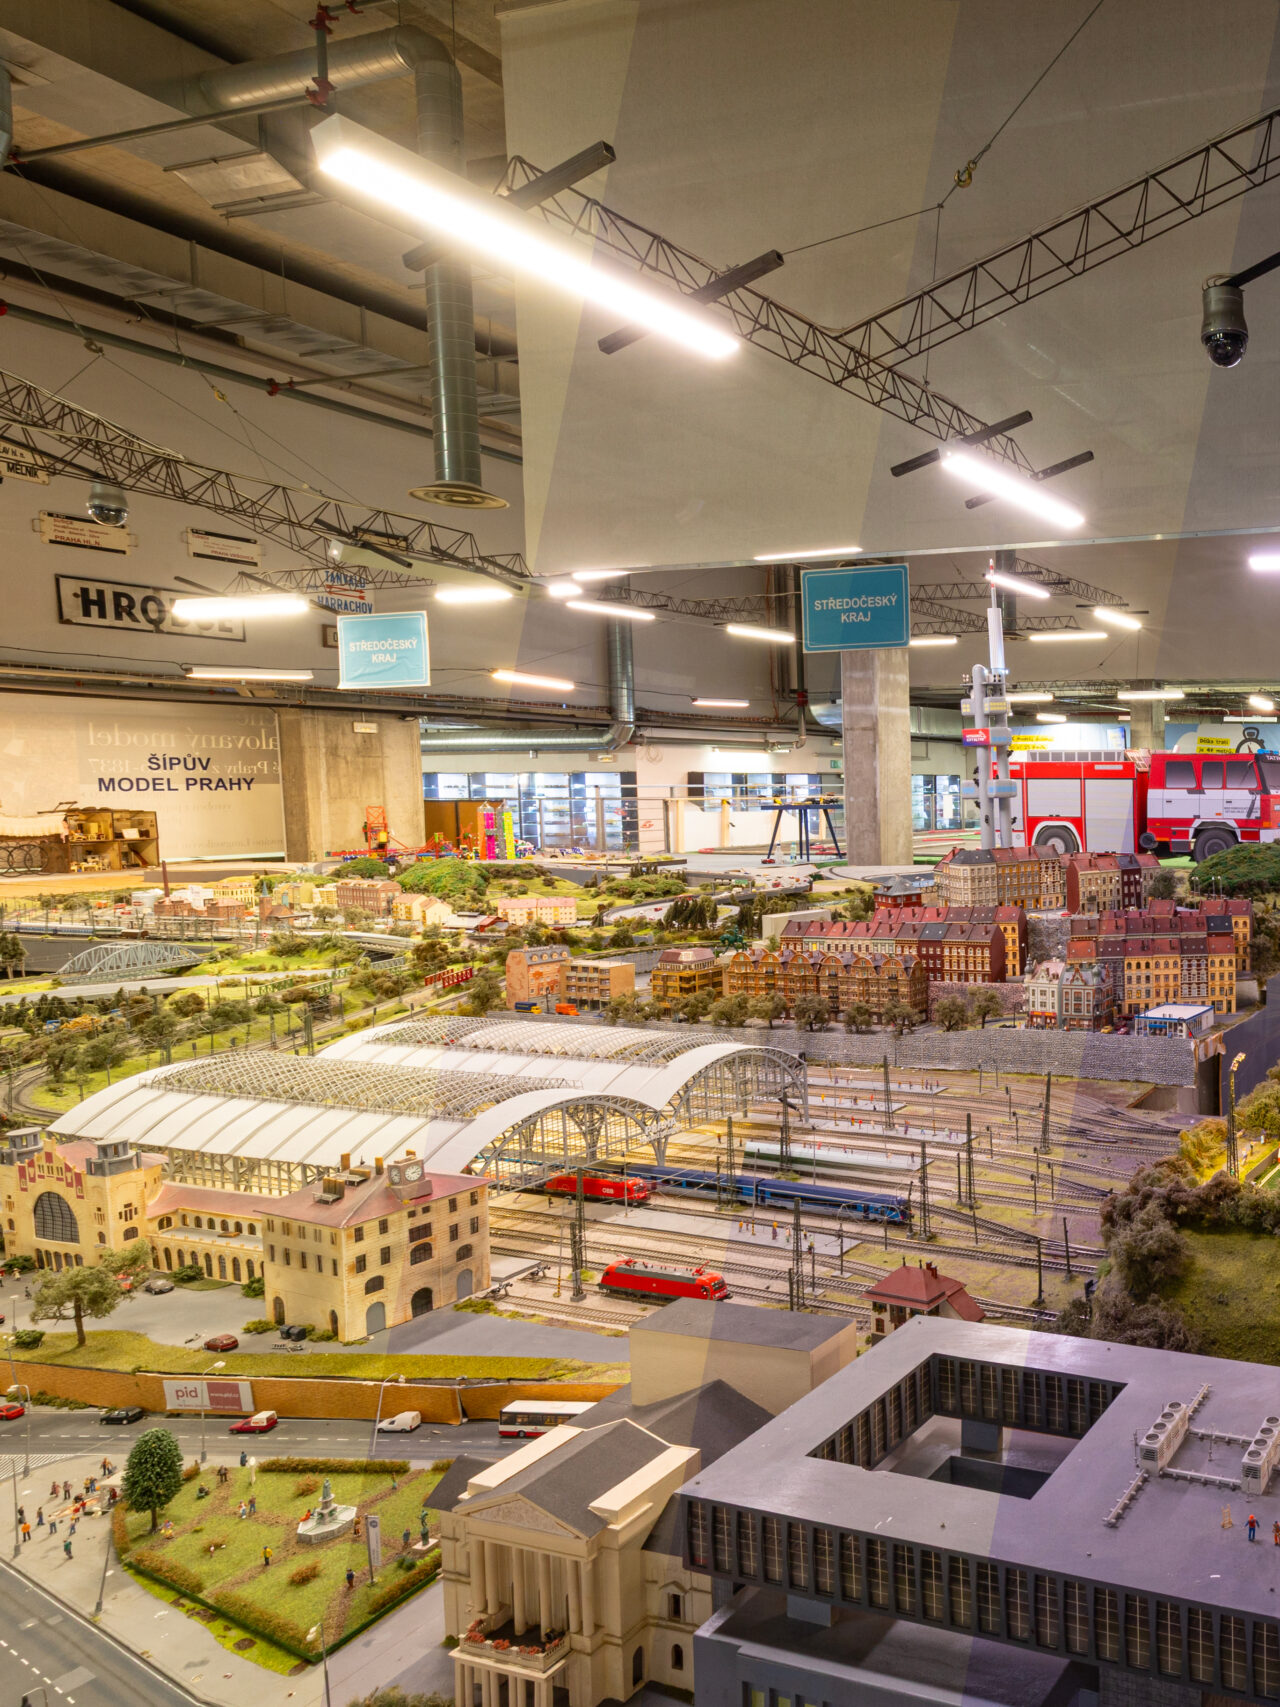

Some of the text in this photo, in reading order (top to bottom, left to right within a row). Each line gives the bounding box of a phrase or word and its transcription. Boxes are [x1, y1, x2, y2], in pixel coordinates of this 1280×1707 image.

[54, 534, 82, 543] PRAHA
[325, 570, 366, 588] TANVALD
[317, 595, 373, 614] HARRACHOV
[814, 593, 897, 611] STŘEDOČESKÝ
[841, 611, 871, 623] KRAJ
[349, 637, 418, 652] STŘEDOČESKÝ
[371, 653, 396, 664] KRAJ
[147, 753, 211, 771] ŠÍPŮV
[98, 777, 255, 792] MODEL PRAHY
[175, 1387, 198, 1400] pid
